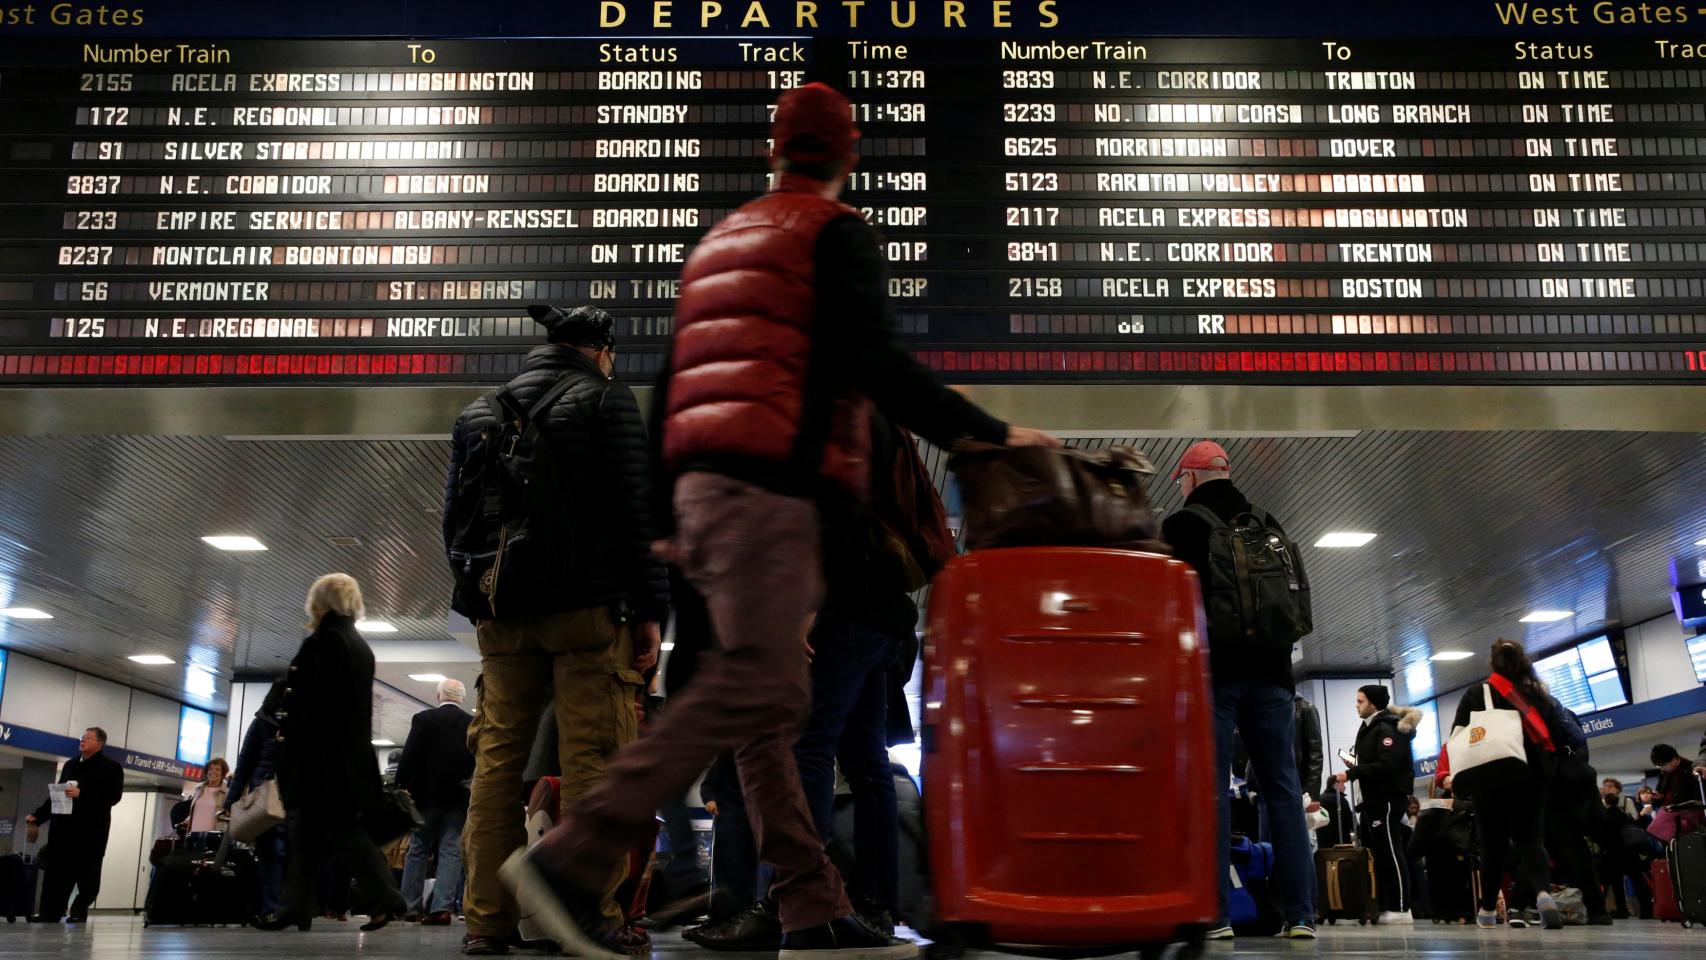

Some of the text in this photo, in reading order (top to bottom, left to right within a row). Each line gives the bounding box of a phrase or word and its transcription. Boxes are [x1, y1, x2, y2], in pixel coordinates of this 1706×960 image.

[0, 4, 143, 25] st Gates
[600, 0, 1058, 27] DEPARTURES
[1496, 2, 1687, 24] West Gates
[84, 42, 804, 63] Number Train To Status Track
[848, 41, 907, 59] Time
[1002, 41, 1088, 59] Number
[1092, 42, 1146, 59] Train
[1323, 43, 1351, 60] To
[1515, 42, 1593, 59] Status
[79, 73, 134, 92] 2155
[172, 73, 236, 92] ACELA
[250, 73, 340, 92] EXPRESS
[404, 72, 534, 91] WASHINGTON
[599, 71, 701, 89] BOARDING
[849, 71, 924, 88] 11:37A
[1003, 71, 1054, 88] 3839
[1093, 71, 1142, 89] N.E.
[1158, 72, 1260, 89] CORRIDOR
[1519, 72, 1544, 88] ON
[1558, 71, 1609, 88] TIME
[90, 107, 129, 127] 172
[167, 107, 218, 127] N.E.
[233, 107, 337, 127] REGONL
[598, 105, 687, 123] STANDBY
[849, 104, 925, 122] 11:43A
[1002, 104, 1057, 123] 3239
[1094, 104, 1133, 123] NO.
[1238, 105, 1302, 124] COAS
[1328, 105, 1379, 123] LONG
[1393, 105, 1470, 123] BRANCH
[1523, 105, 1548, 122] ON
[1562, 105, 1613, 122] TIME
[99, 141, 123, 161] 91
[164, 141, 244, 161] SILVER
[596, 139, 700, 157] BOARDING
[1005, 138, 1617, 157] 6625 MORRISTOWN DOVER ON TIME
[68, 176, 120, 195] 3837
[160, 176, 209, 194] N.E.
[227, 175, 332, 194] CORRIDOR
[594, 174, 699, 192] BOARDING
[850, 173, 926, 190] 11:49A
[1006, 173, 1058, 191] 5123
[1099, 173, 1189, 191] RARTA
[1202, 173, 1279, 191] VALLEY
[1530, 174, 1555, 191] ON
[1569, 174, 1621, 191] TIME
[77, 209, 698, 230] 233 EMPIRE SERVICE ALBANY-RENSSEL BOARDING
[860, 206, 927, 226] 2:00P
[1007, 208, 1058, 225] 2117
[1100, 208, 1164, 226] ACELA
[1178, 208, 1271, 227] EXPRESS
[1534, 209, 1560, 227] ON
[1573, 209, 1626, 226] TIME
[58, 246, 113, 265] 6237
[152, 246, 272, 265] MONTCLAIR
[285, 245, 379, 264] BOONTON
[592, 245, 617, 263] ON
[632, 244, 684, 262] TIME
[1008, 243, 1056, 261] 3841
[1101, 243, 1152, 262] N.E.
[1168, 243, 1273, 261] CORRIDOR
[1340, 244, 1431, 262] TRENTON
[1538, 244, 1564, 262] ON
[1578, 244, 1630, 261] TIME
[82, 279, 683, 300] 56 VERMONTER ST. ALBANS ON TIME
[1010, 278, 1062, 296] 2158
[1103, 279, 1169, 297] ACELA
[1183, 279, 1275, 297] EXPRESS
[1343, 279, 1421, 297] BOSTON
[1542, 279, 1568, 297] ON
[1579, 279, 1635, 297] TIME
[64, 317, 674, 338] 125 N.E. REGONAL NORFOLK TIM
[1198, 315, 1227, 333] RR
